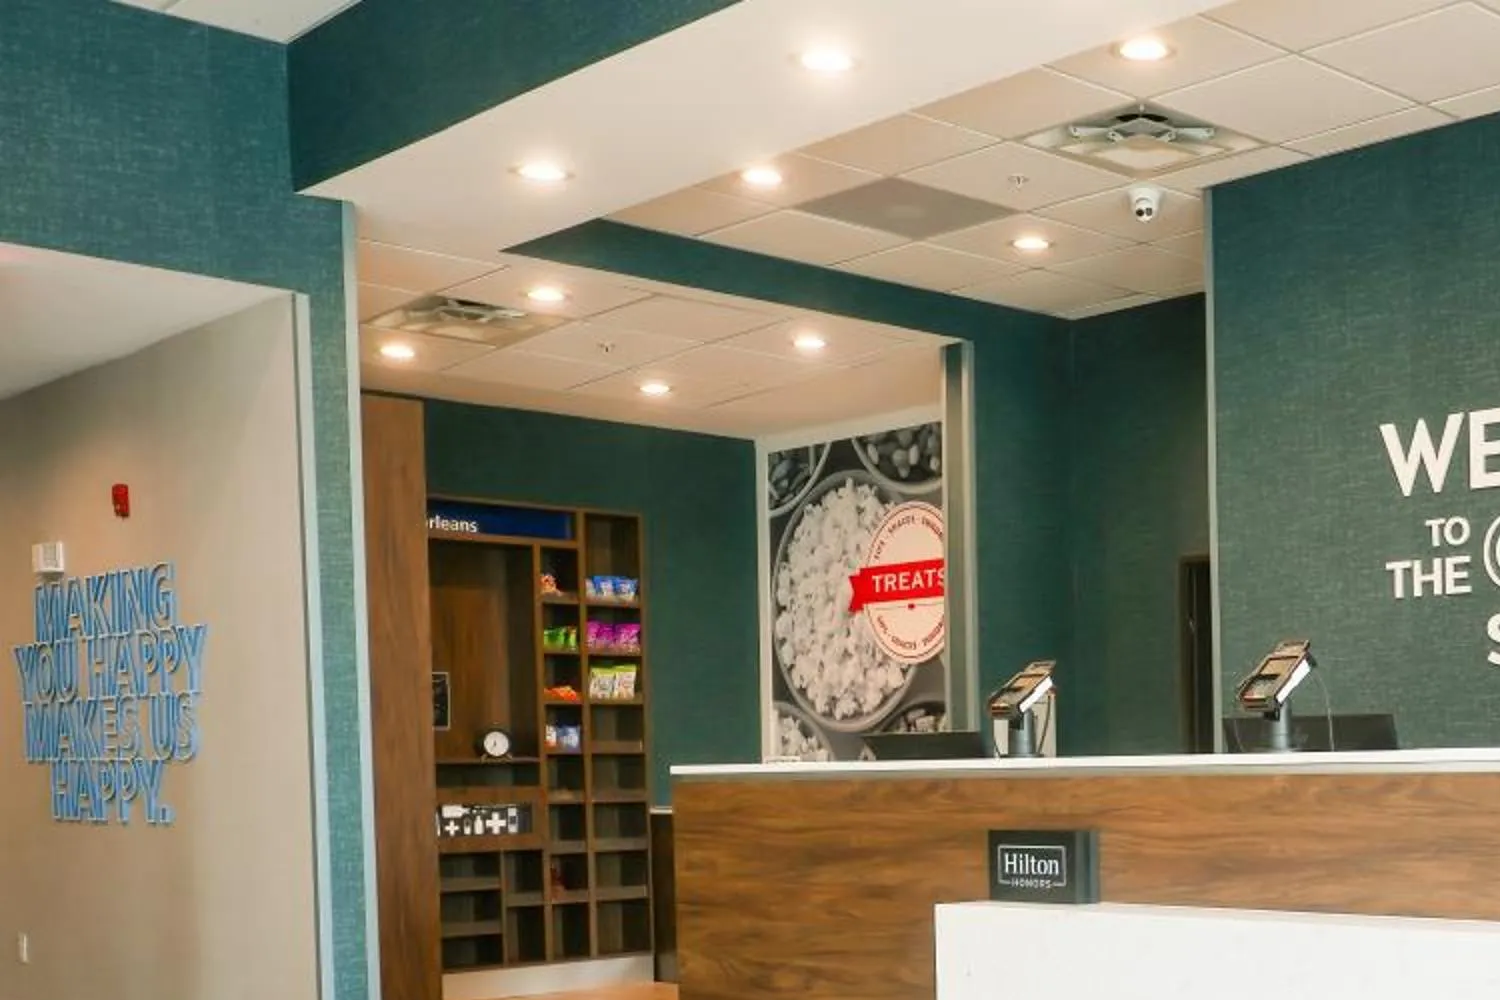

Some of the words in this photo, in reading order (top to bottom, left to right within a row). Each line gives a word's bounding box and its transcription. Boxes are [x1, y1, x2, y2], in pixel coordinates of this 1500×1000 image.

[427, 513, 478, 533] rleans
[1425, 516, 1470, 548] TO
[35, 562, 174, 645] MAKING
[1386, 555, 1471, 599] THE
[14, 638, 79, 703] YOU
[86, 624, 206, 701] HAPPY
[23, 693, 138, 764] MAKES
[150, 692, 198, 764] US
[52, 757, 174, 825] HAPPY.
[1004, 853, 1060, 875] Hilton
